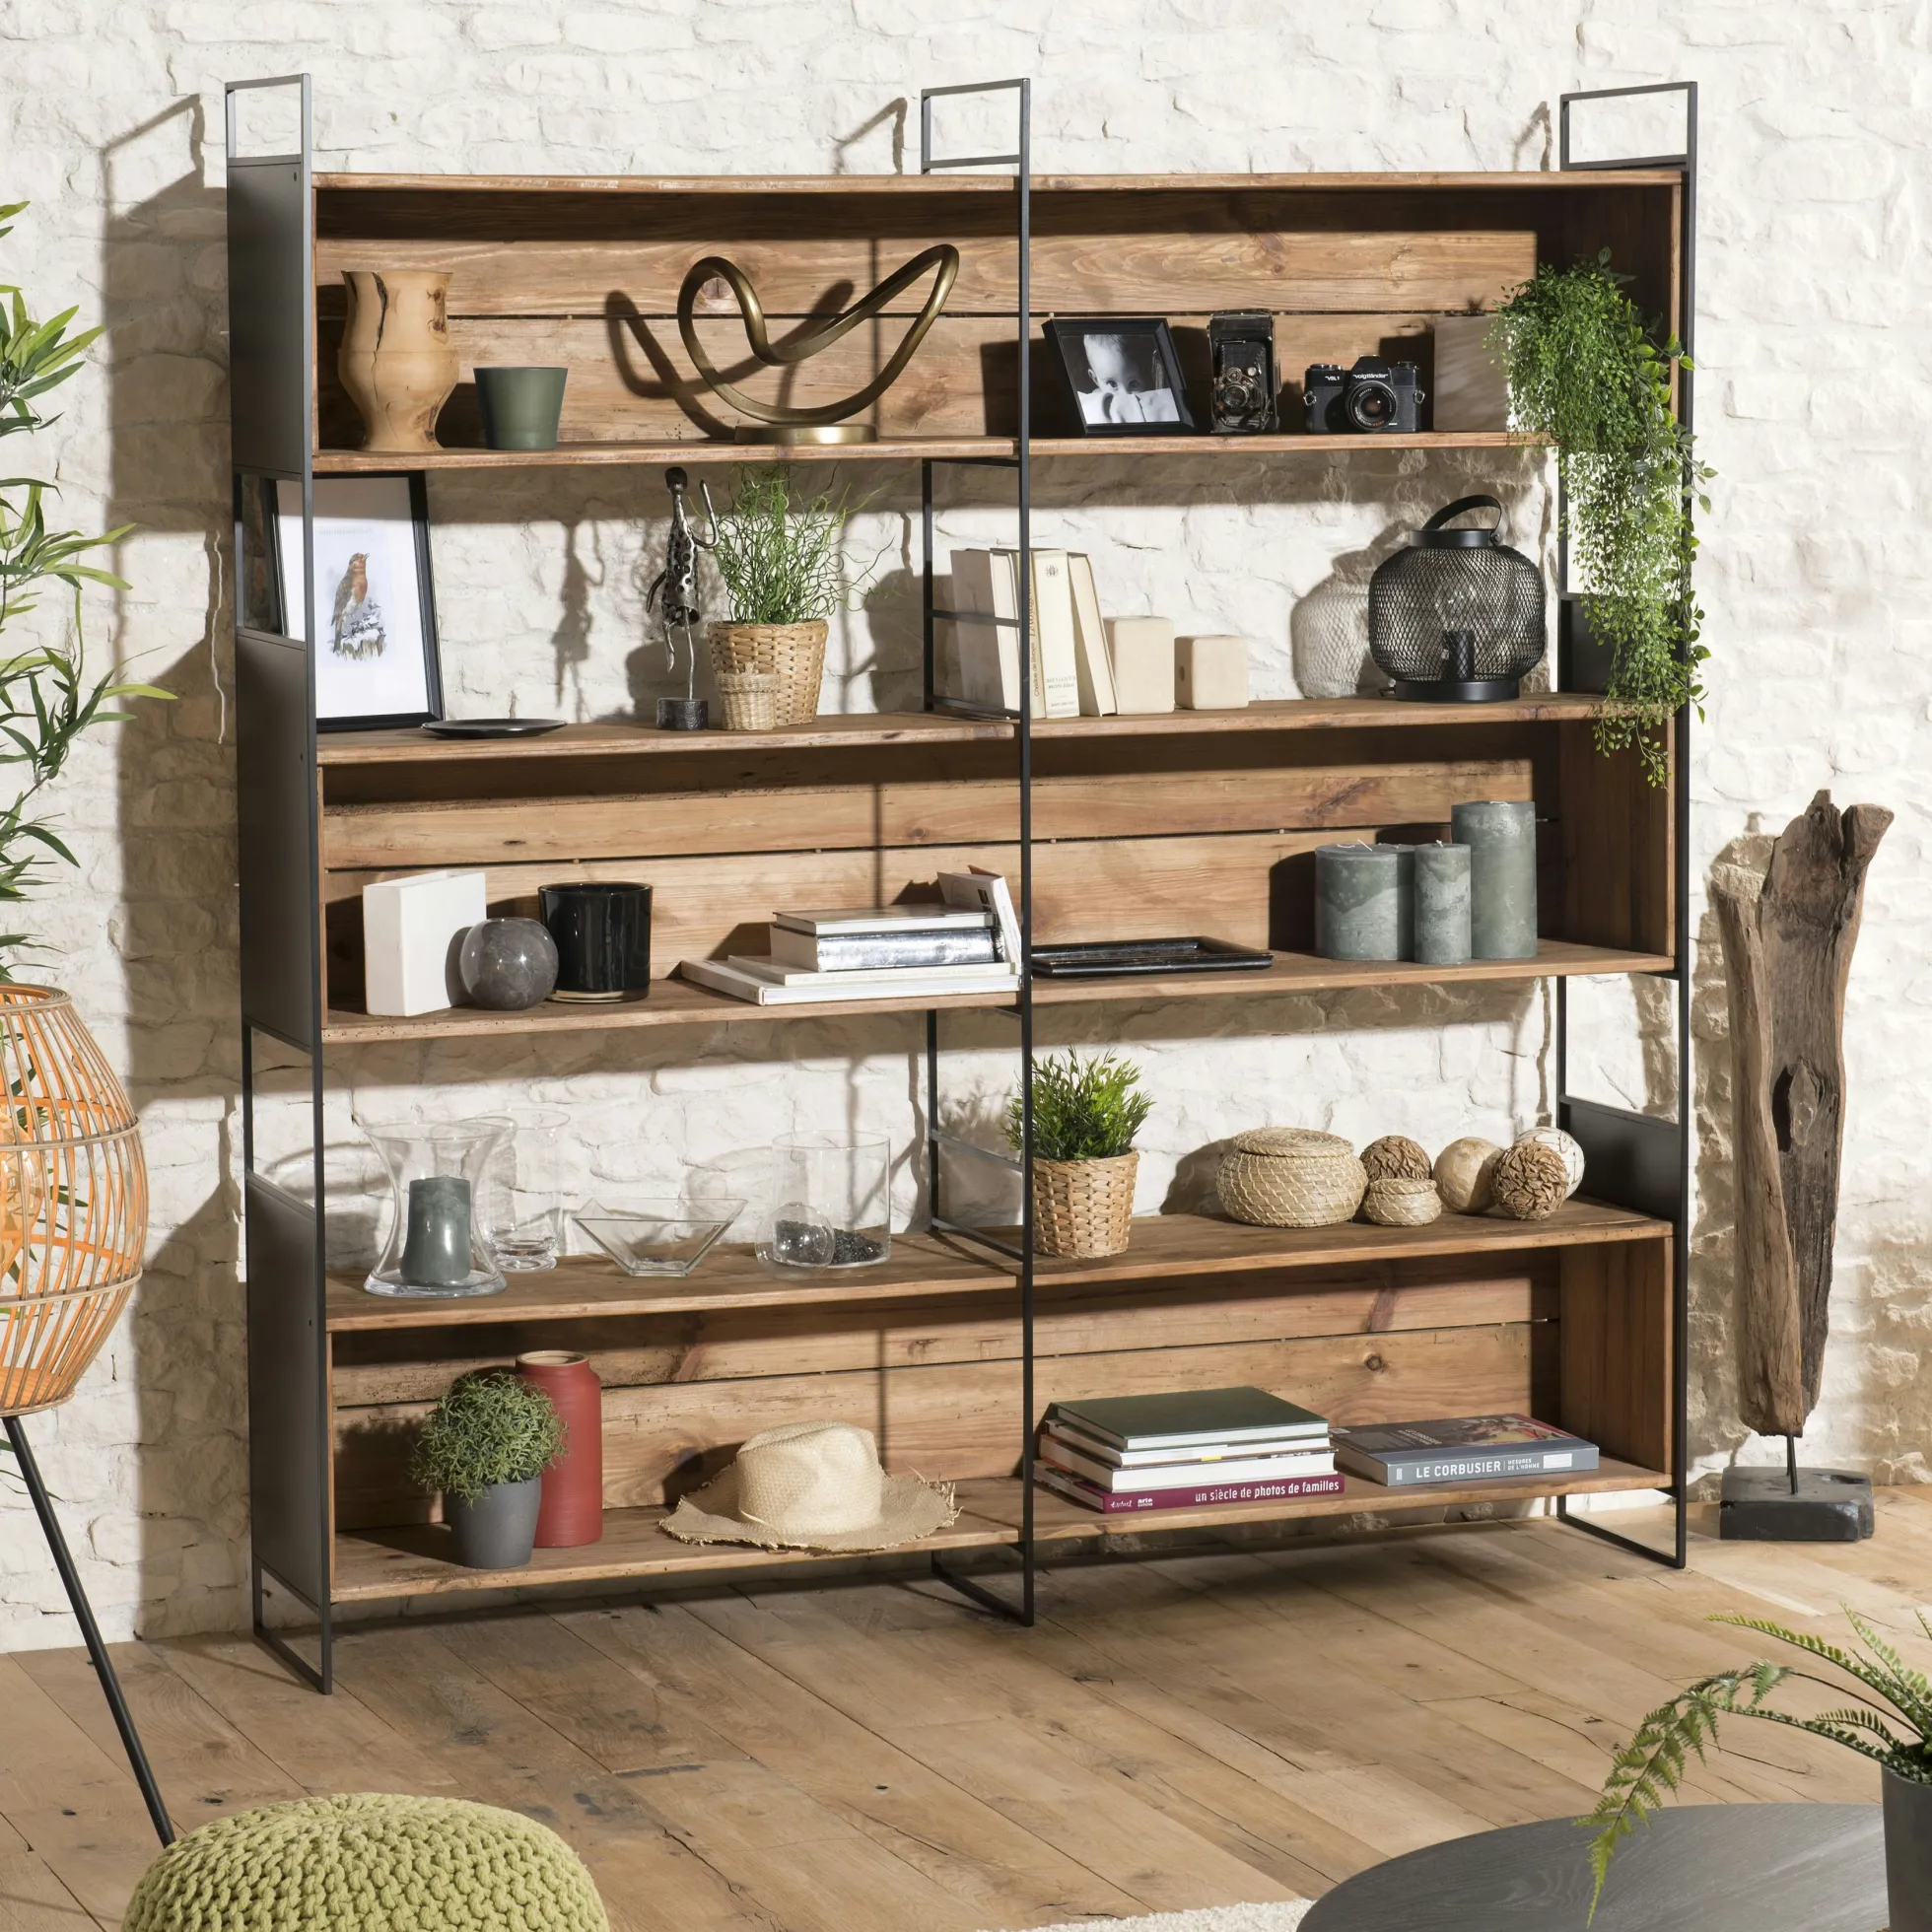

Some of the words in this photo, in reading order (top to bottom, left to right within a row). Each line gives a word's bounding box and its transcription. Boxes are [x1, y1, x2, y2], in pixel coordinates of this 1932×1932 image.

[1415, 1465, 1430, 1479] LE
[1434, 1460, 1501, 1477] CORBUSIER
[1195, 1492, 1207, 1502] un
[1209, 1488, 1237, 1501] siècle
[1240, 1487, 1252, 1498] de
[1254, 1484, 1285, 1499] photos
[1288, 1483, 1299, 1494] de
[1302, 1480, 1340, 1493] familles
